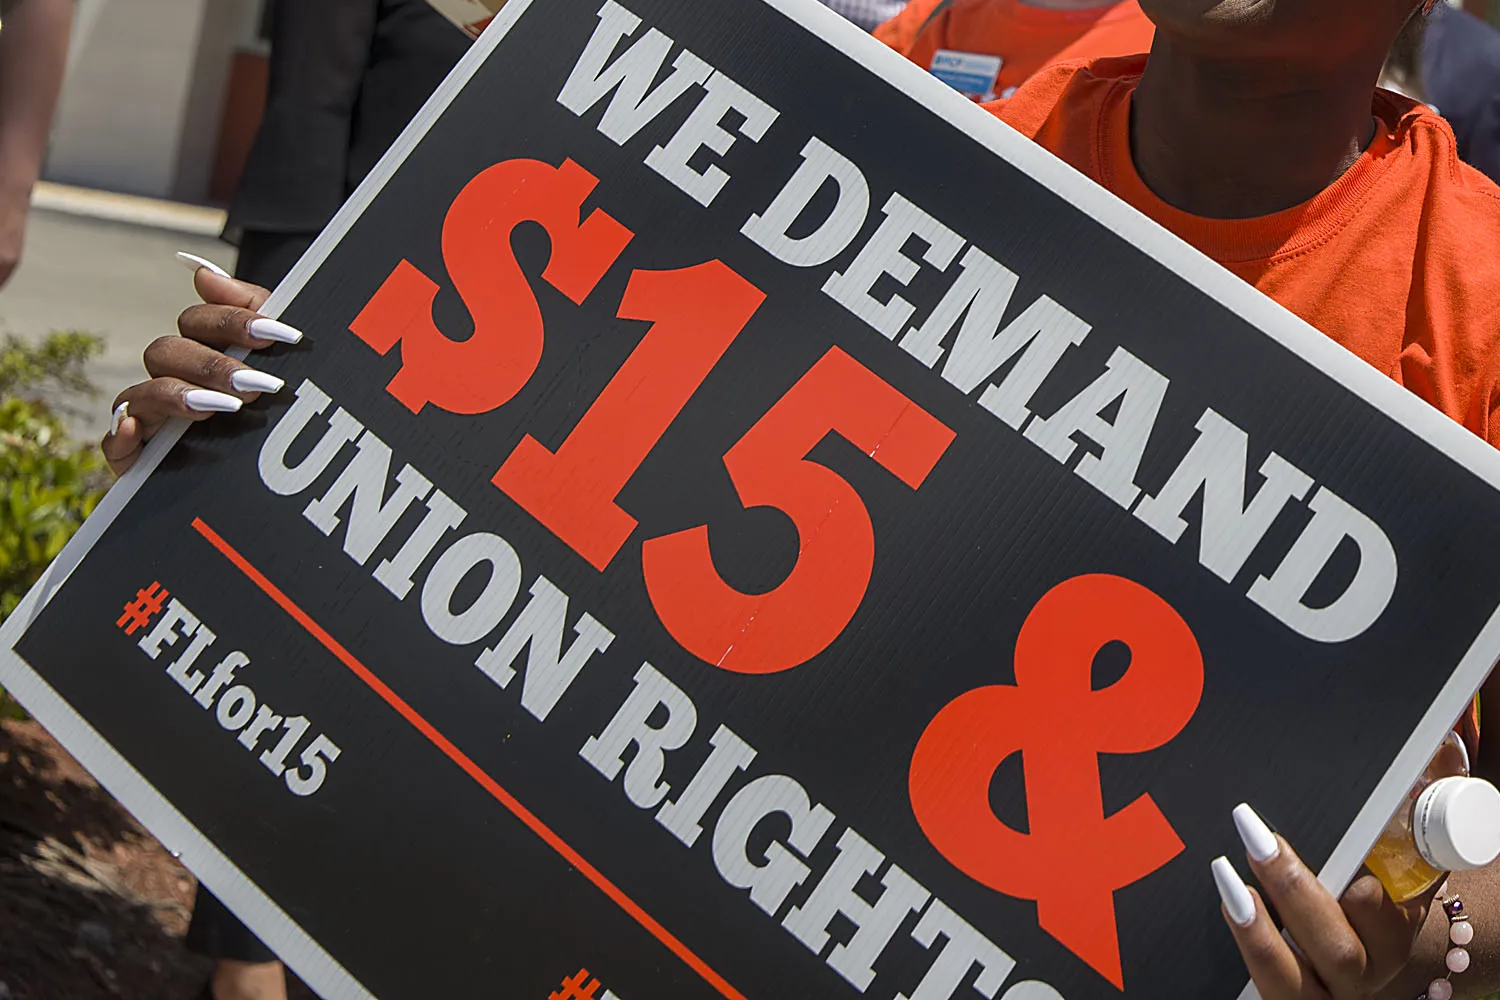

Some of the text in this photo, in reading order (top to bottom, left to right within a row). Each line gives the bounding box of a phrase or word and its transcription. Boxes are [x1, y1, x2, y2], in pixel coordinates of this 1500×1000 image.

[348, 157, 1204, 992] $15 &
[740, 135, 1398, 643] DEMAND
[115, 581, 341, 796] #FLfor15
[257, 378, 1065, 1000] UNION RIGHT
